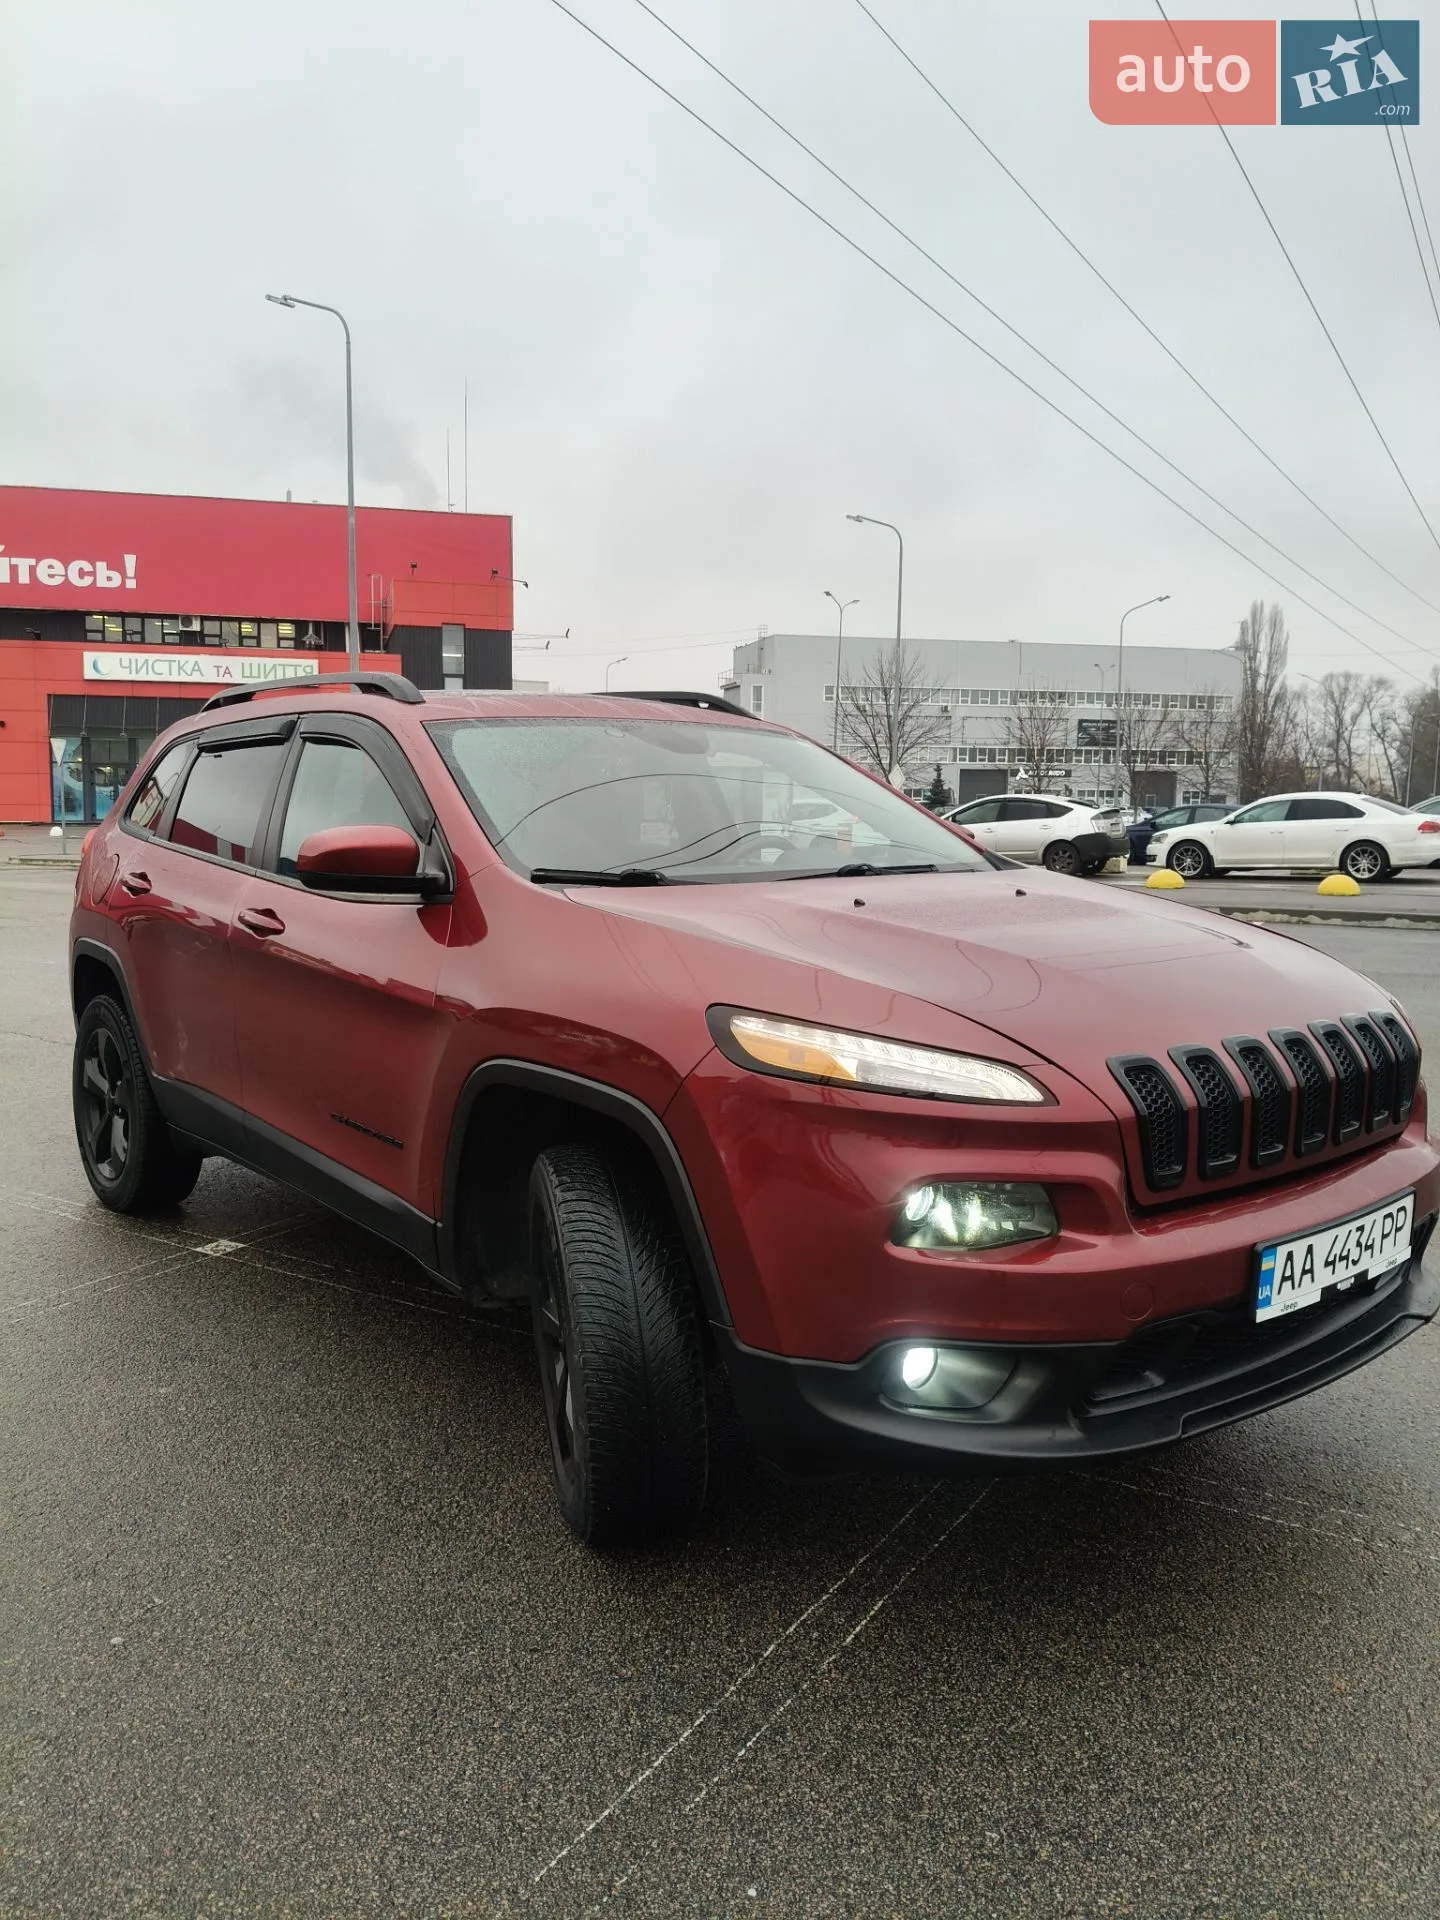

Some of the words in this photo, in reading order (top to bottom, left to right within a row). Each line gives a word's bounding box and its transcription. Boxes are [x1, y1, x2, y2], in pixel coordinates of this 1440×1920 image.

[119, 656, 204, 677] ЧИСТКА
[213, 664, 233, 678] ТА
[241, 662, 314, 680] ШИТТЯ
[1277, 1243, 1315, 1295] AA
[1324, 1219, 1377, 1275] 4434
[1380, 1205, 1408, 1254] PP
[1385, 1257, 1398, 1268] Jeep
[1258, 1285, 1271, 1300] UA
[1280, 1301, 1298, 1313] Jeep
